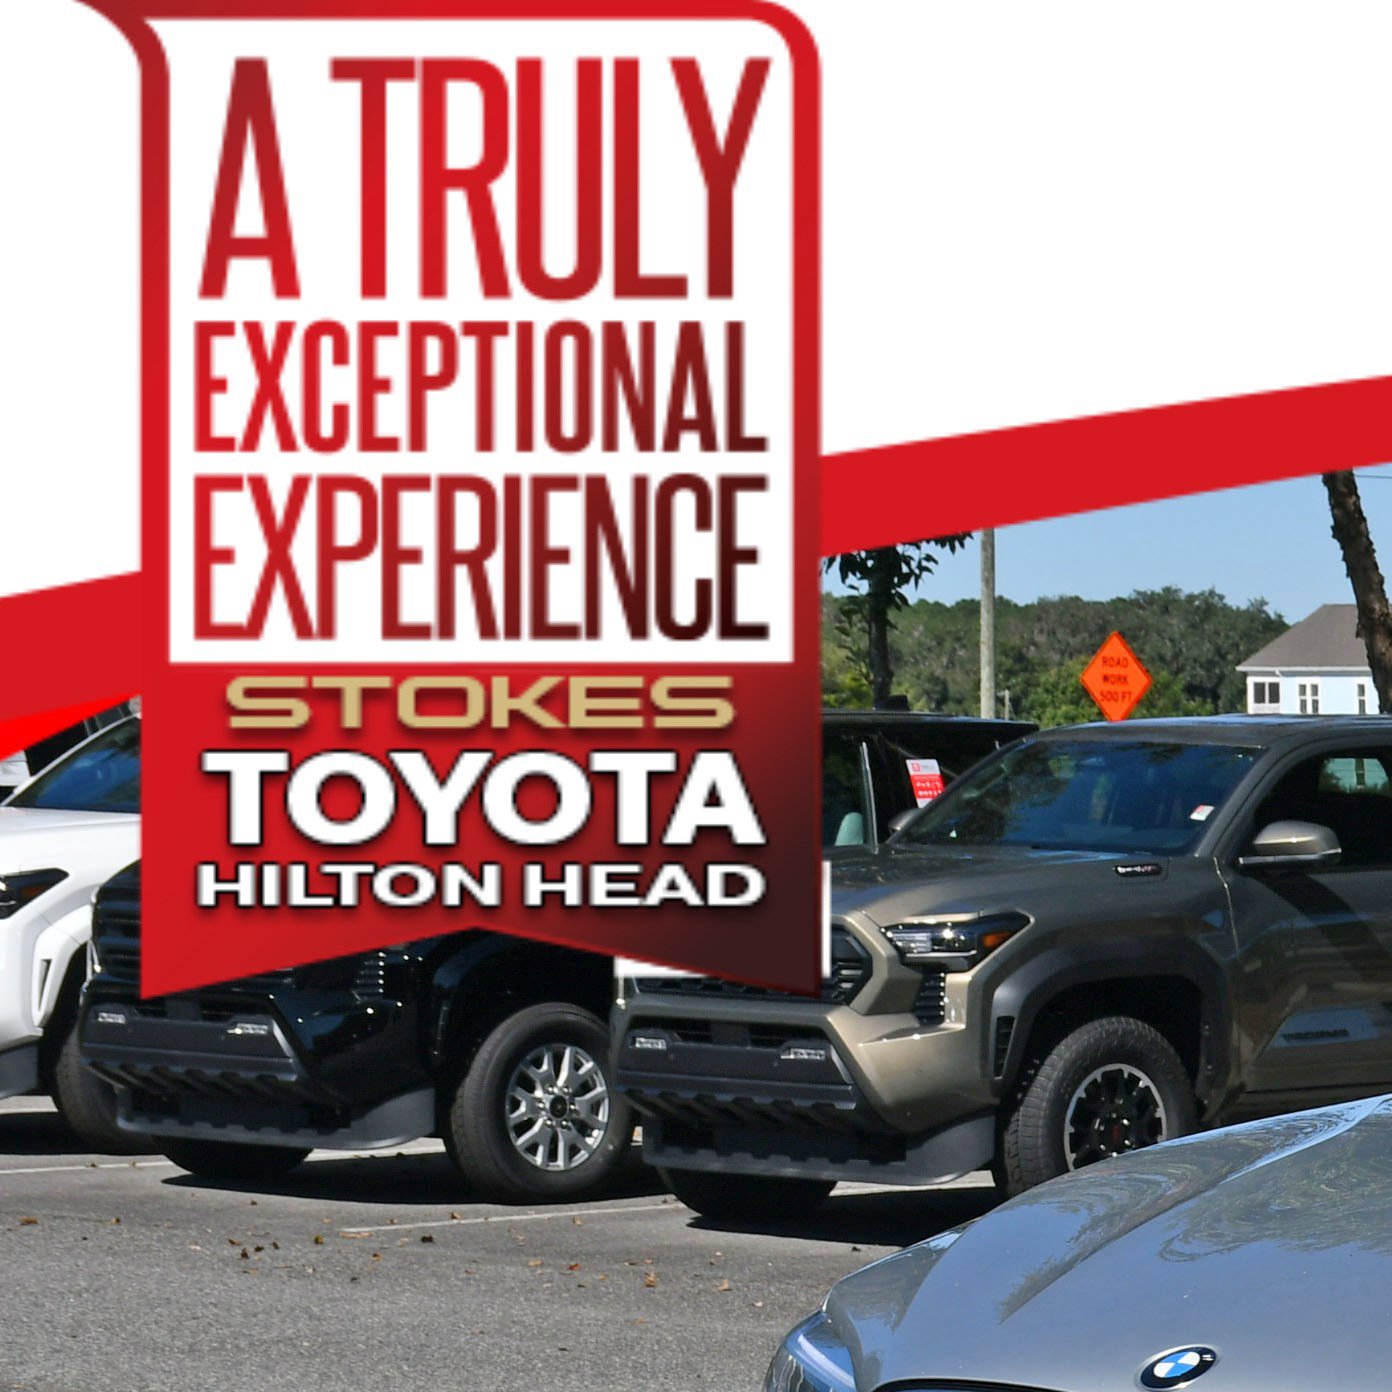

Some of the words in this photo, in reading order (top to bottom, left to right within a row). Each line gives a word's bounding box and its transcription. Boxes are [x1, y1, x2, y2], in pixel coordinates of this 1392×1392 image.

[1102, 656, 1129, 668] ROAD
[1103, 674, 1129, 685] WORK
[1121, 691, 1132, 702] FT
